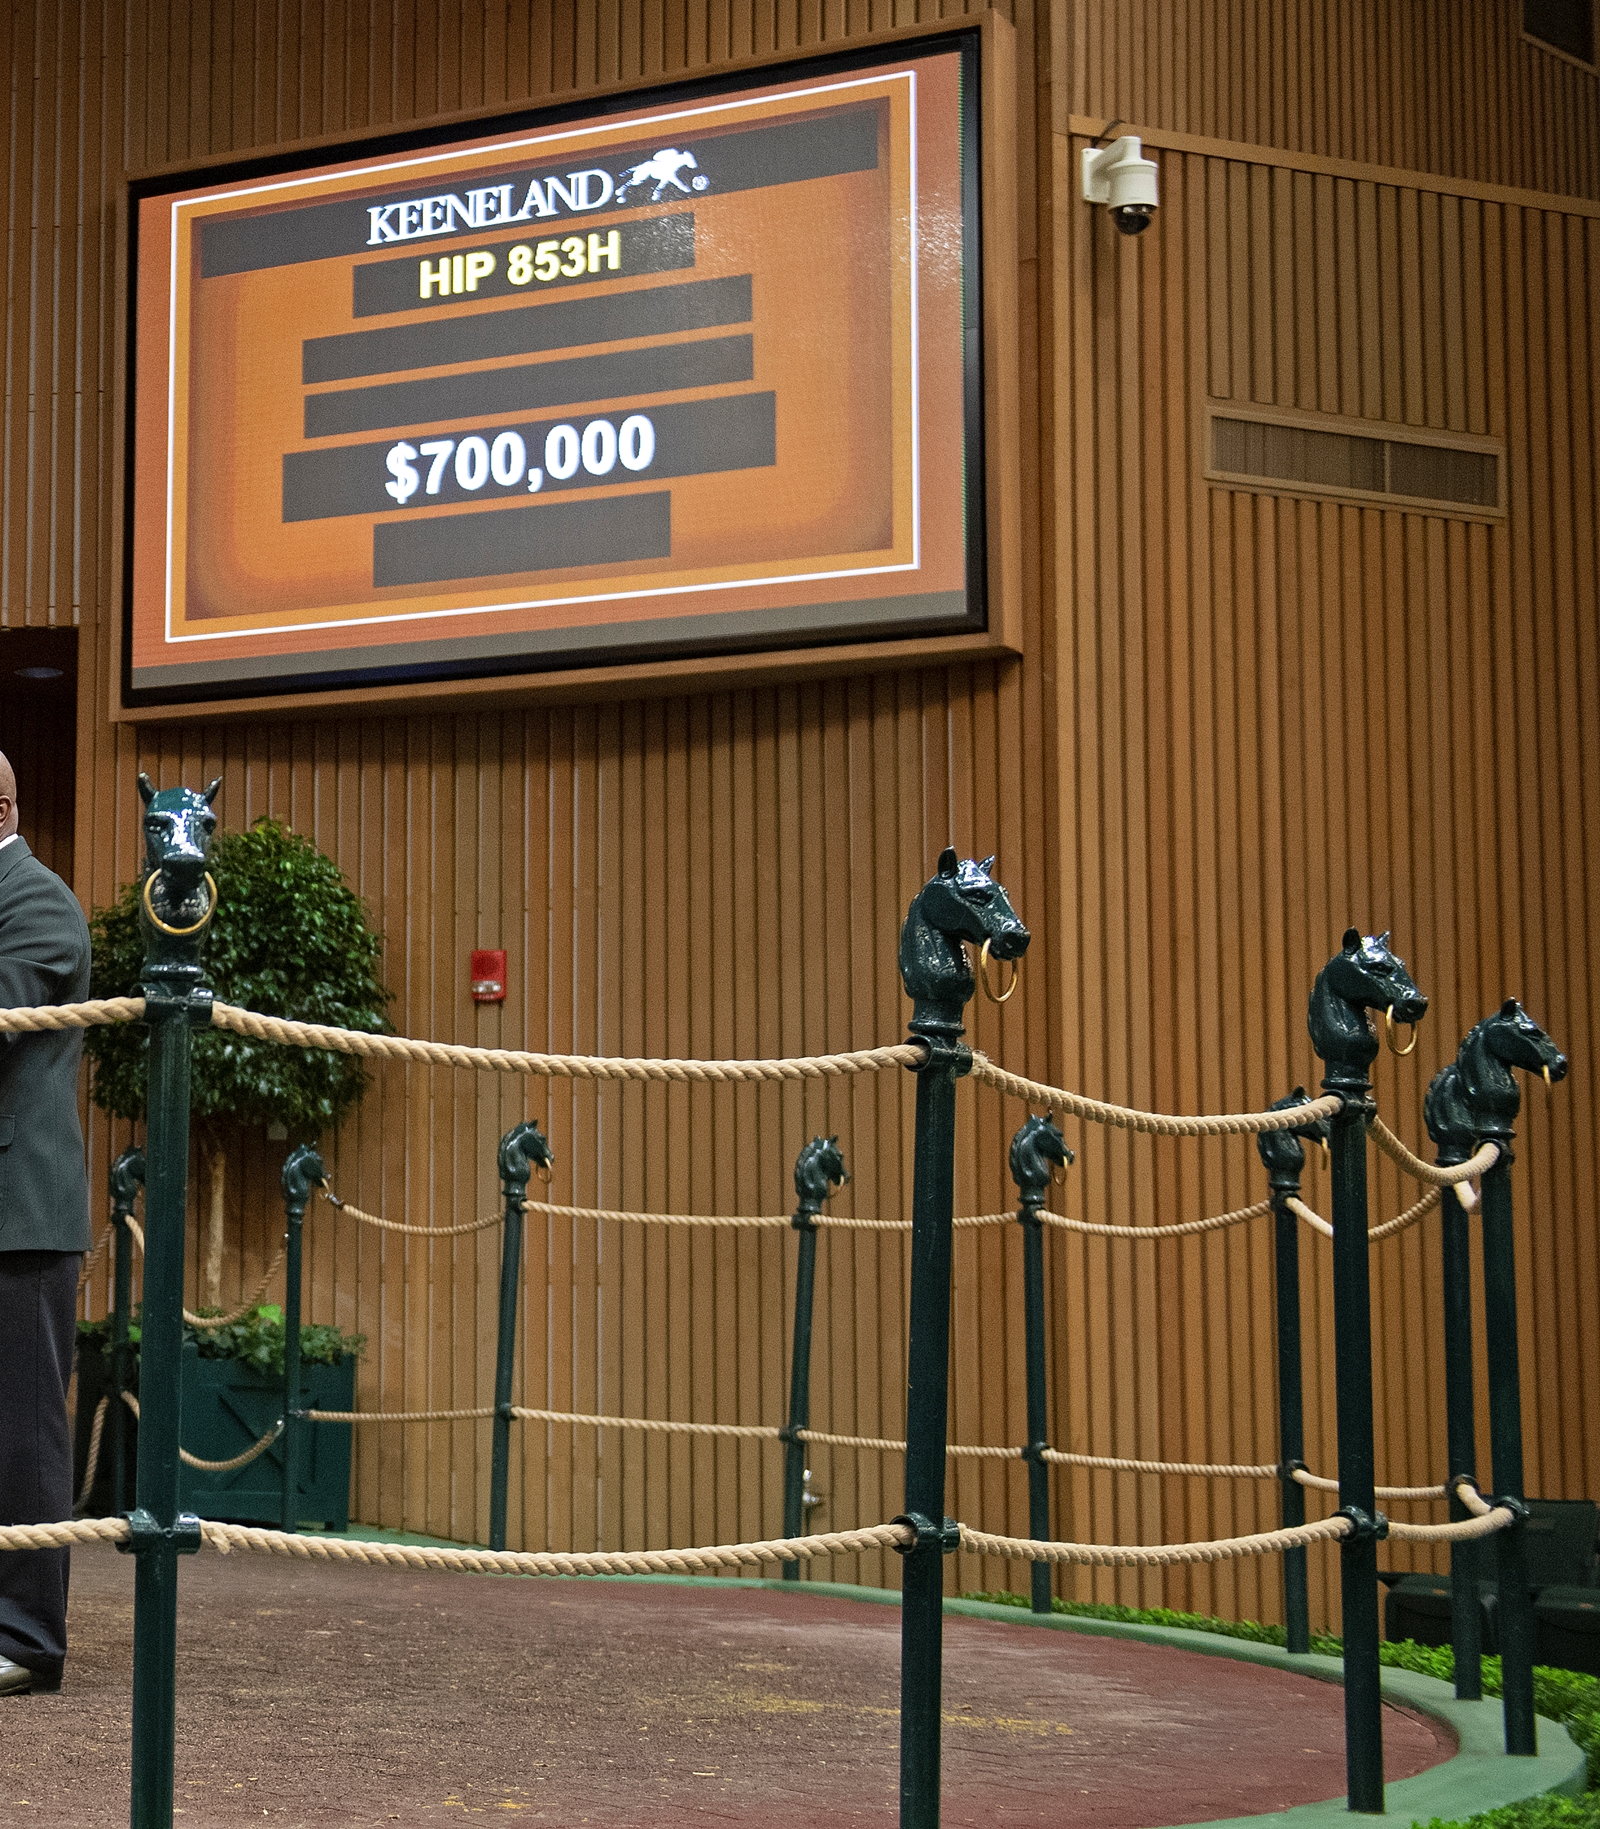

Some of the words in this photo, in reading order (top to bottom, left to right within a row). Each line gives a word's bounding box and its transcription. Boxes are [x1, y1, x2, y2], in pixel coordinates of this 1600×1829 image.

[366, 169, 614, 245] KEENELAND
[419, 251, 496, 299] HIP
[507, 230, 621, 286] 853H
[385, 415, 655, 504] $700,000
